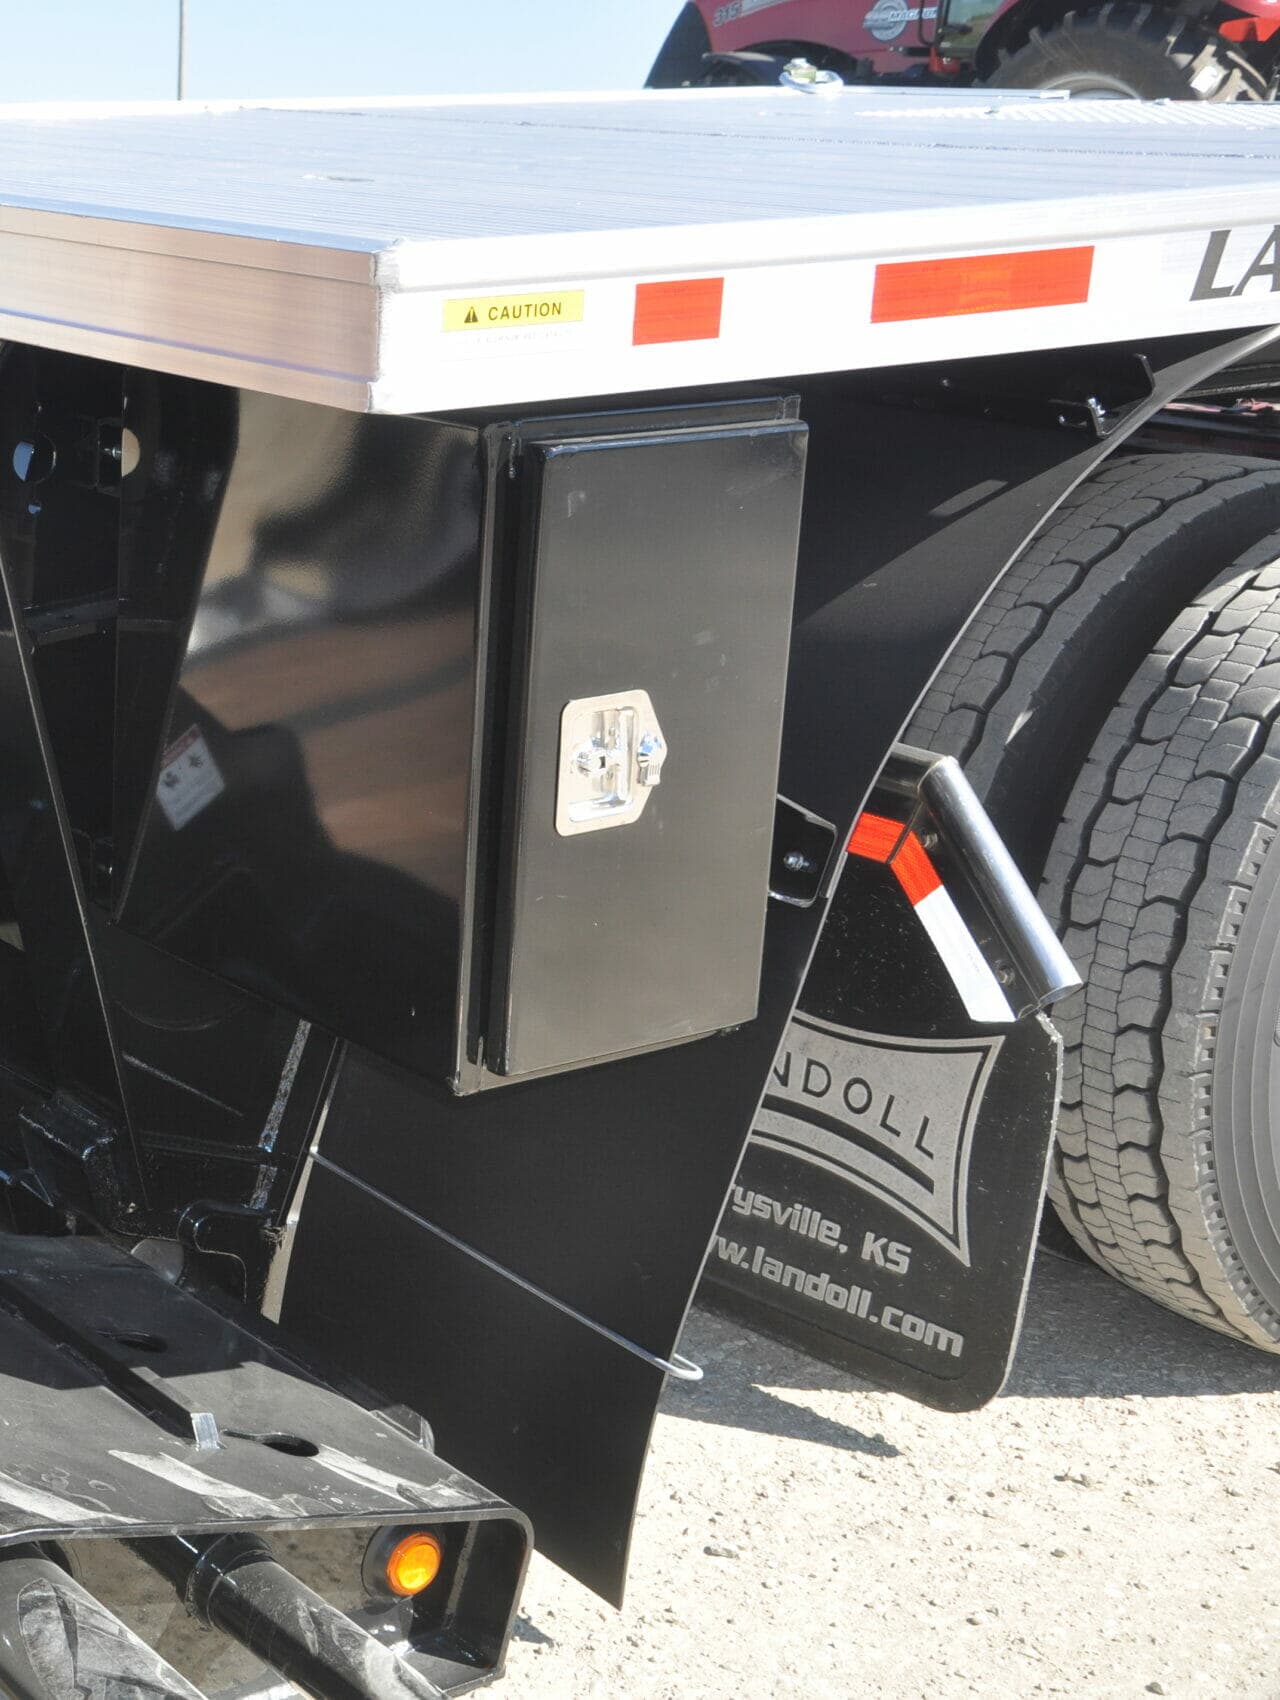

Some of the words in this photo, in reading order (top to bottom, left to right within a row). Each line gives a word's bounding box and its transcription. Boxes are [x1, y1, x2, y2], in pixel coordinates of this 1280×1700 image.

[487, 301, 563, 321] CAUTION
[731, 1184, 849, 1254] ysville,
[861, 1231, 913, 1275] KS
